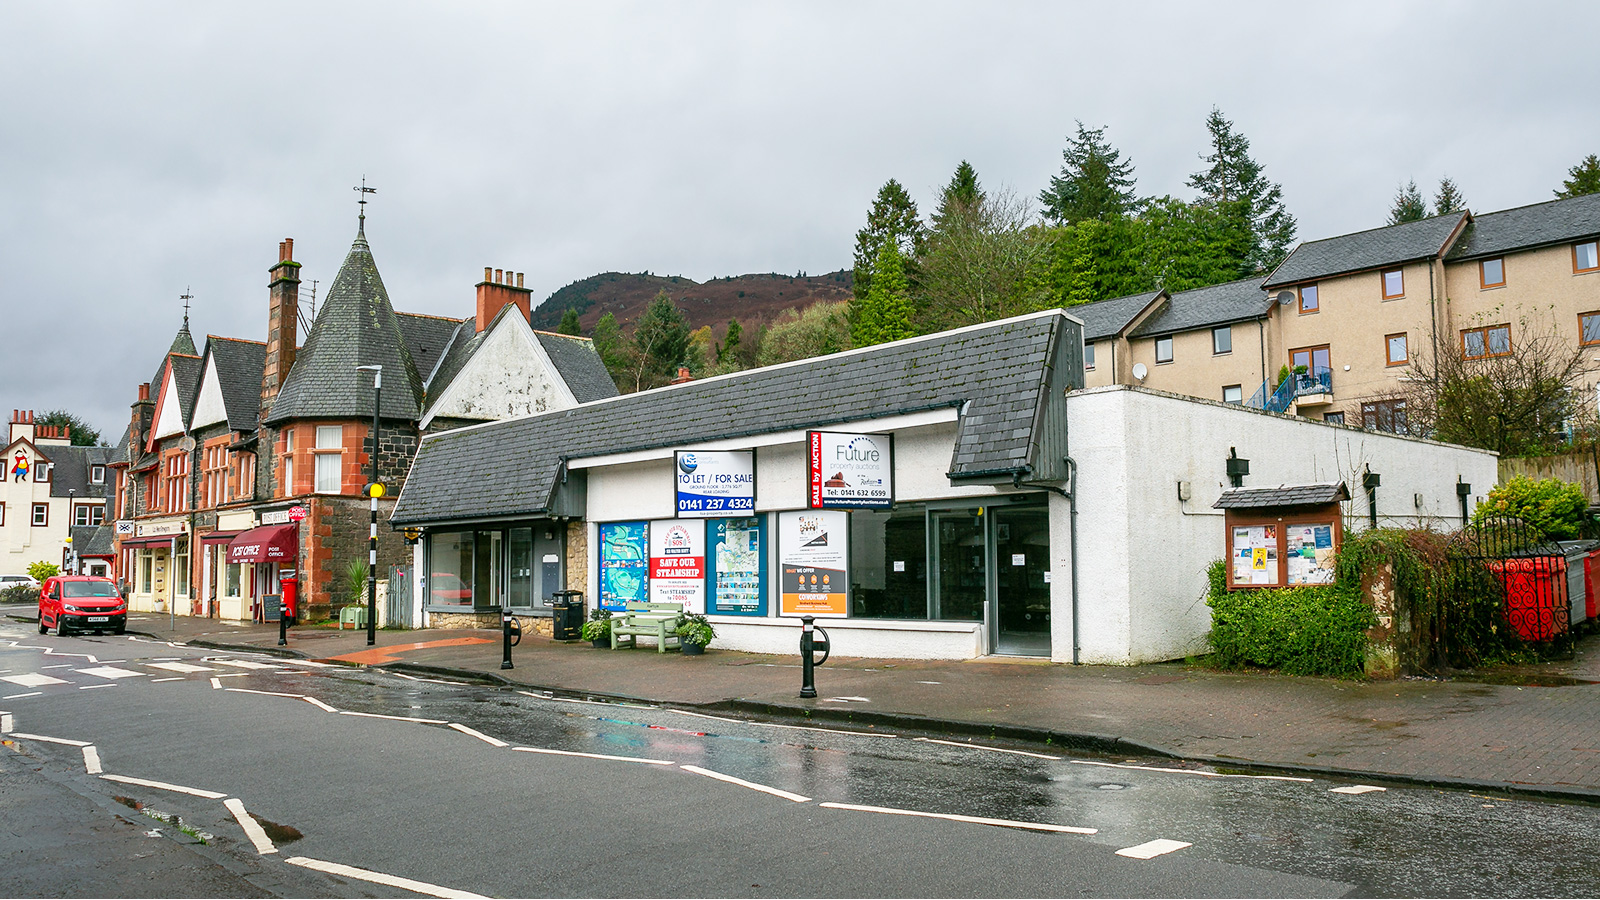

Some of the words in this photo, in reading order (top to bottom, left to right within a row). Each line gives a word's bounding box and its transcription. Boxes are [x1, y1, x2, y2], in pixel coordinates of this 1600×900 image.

[836, 444, 880, 462] Future
[829, 463, 854, 471] property
[678, 474, 690, 484] TO
[692, 474, 706, 484] LET
[715, 474, 732, 483] FOR
[734, 473, 753, 483] SALE
[812, 471, 820, 482] by
[812, 485, 820, 505] SALE
[870, 489, 887, 497] 6599
[679, 499, 703, 510] 0141
[706, 499, 725, 510] 237
[727, 498, 753, 509] 4324
[263, 513, 273, 523] POST
[273, 511, 287, 522] OFFICE
[232, 546, 244, 557] POST
[243, 544, 260, 556] OFFICE
[659, 559, 678, 567] SAVE
[679, 558, 696, 567] OUR
[656, 568, 700, 577] STEAMSHIP
